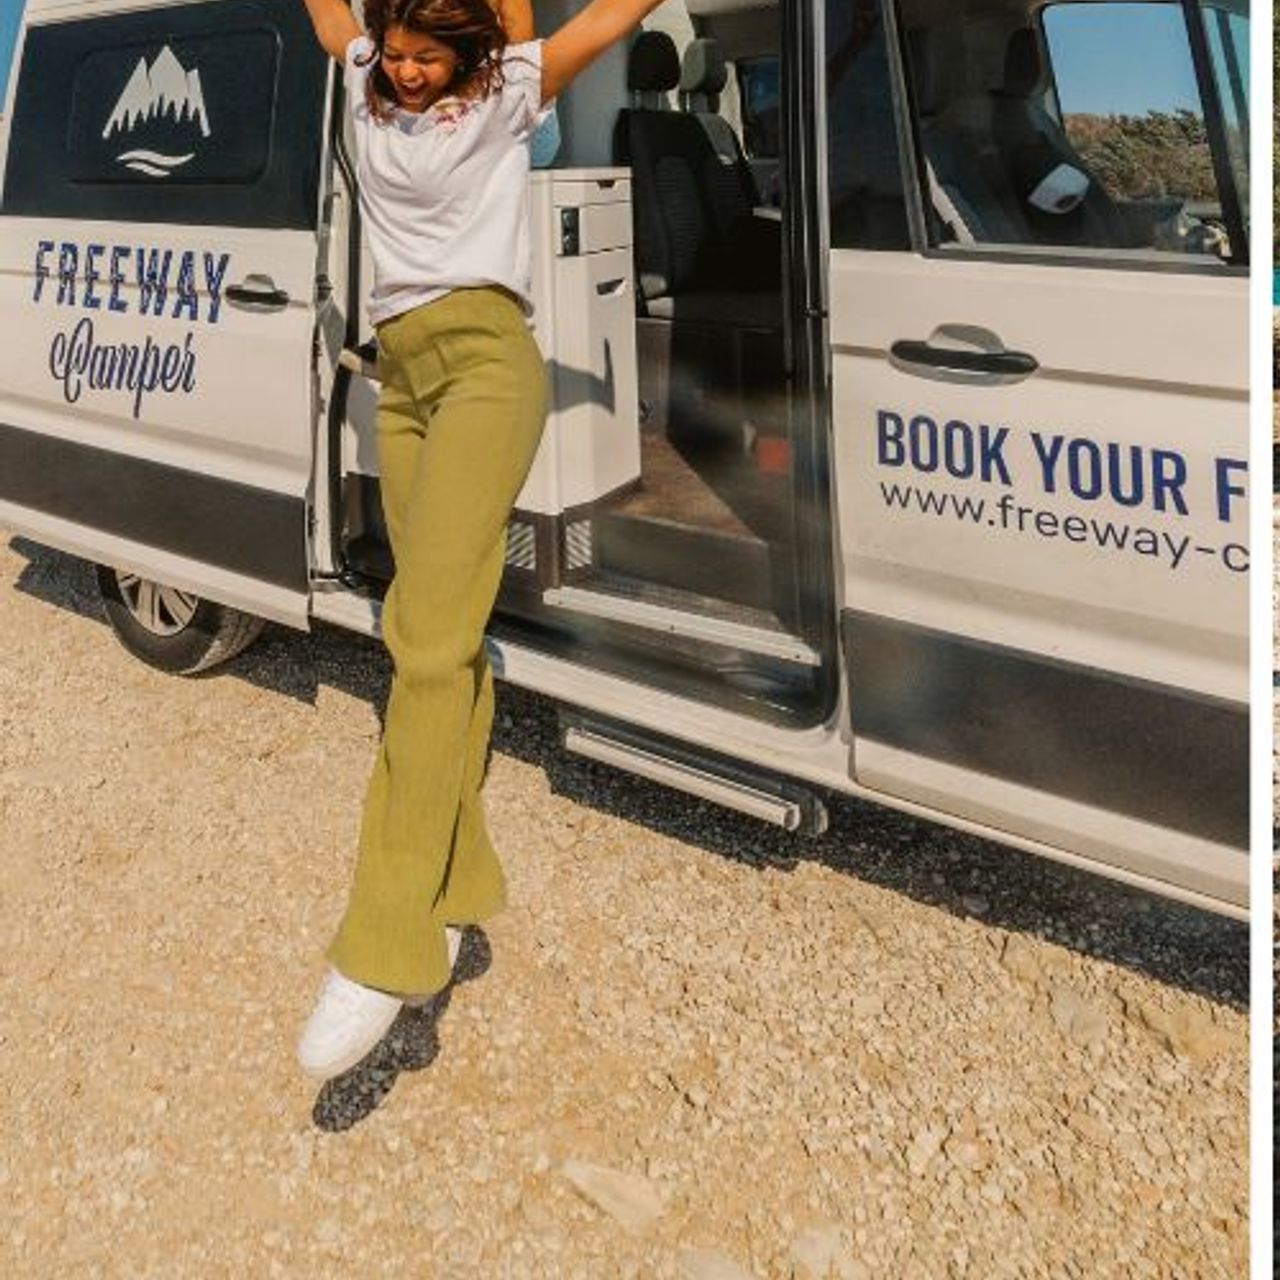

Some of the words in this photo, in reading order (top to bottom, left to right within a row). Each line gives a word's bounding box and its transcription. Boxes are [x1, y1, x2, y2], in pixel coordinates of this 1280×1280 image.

[33, 240, 230, 323] FREEWAY
[49, 317, 196, 419] Camper
[876, 409, 1013, 486] BOOK
[1029, 431, 1190, 517] YOUR
[1214, 456, 1249, 523] F
[879, 481, 1249, 573] www.freeway-c
